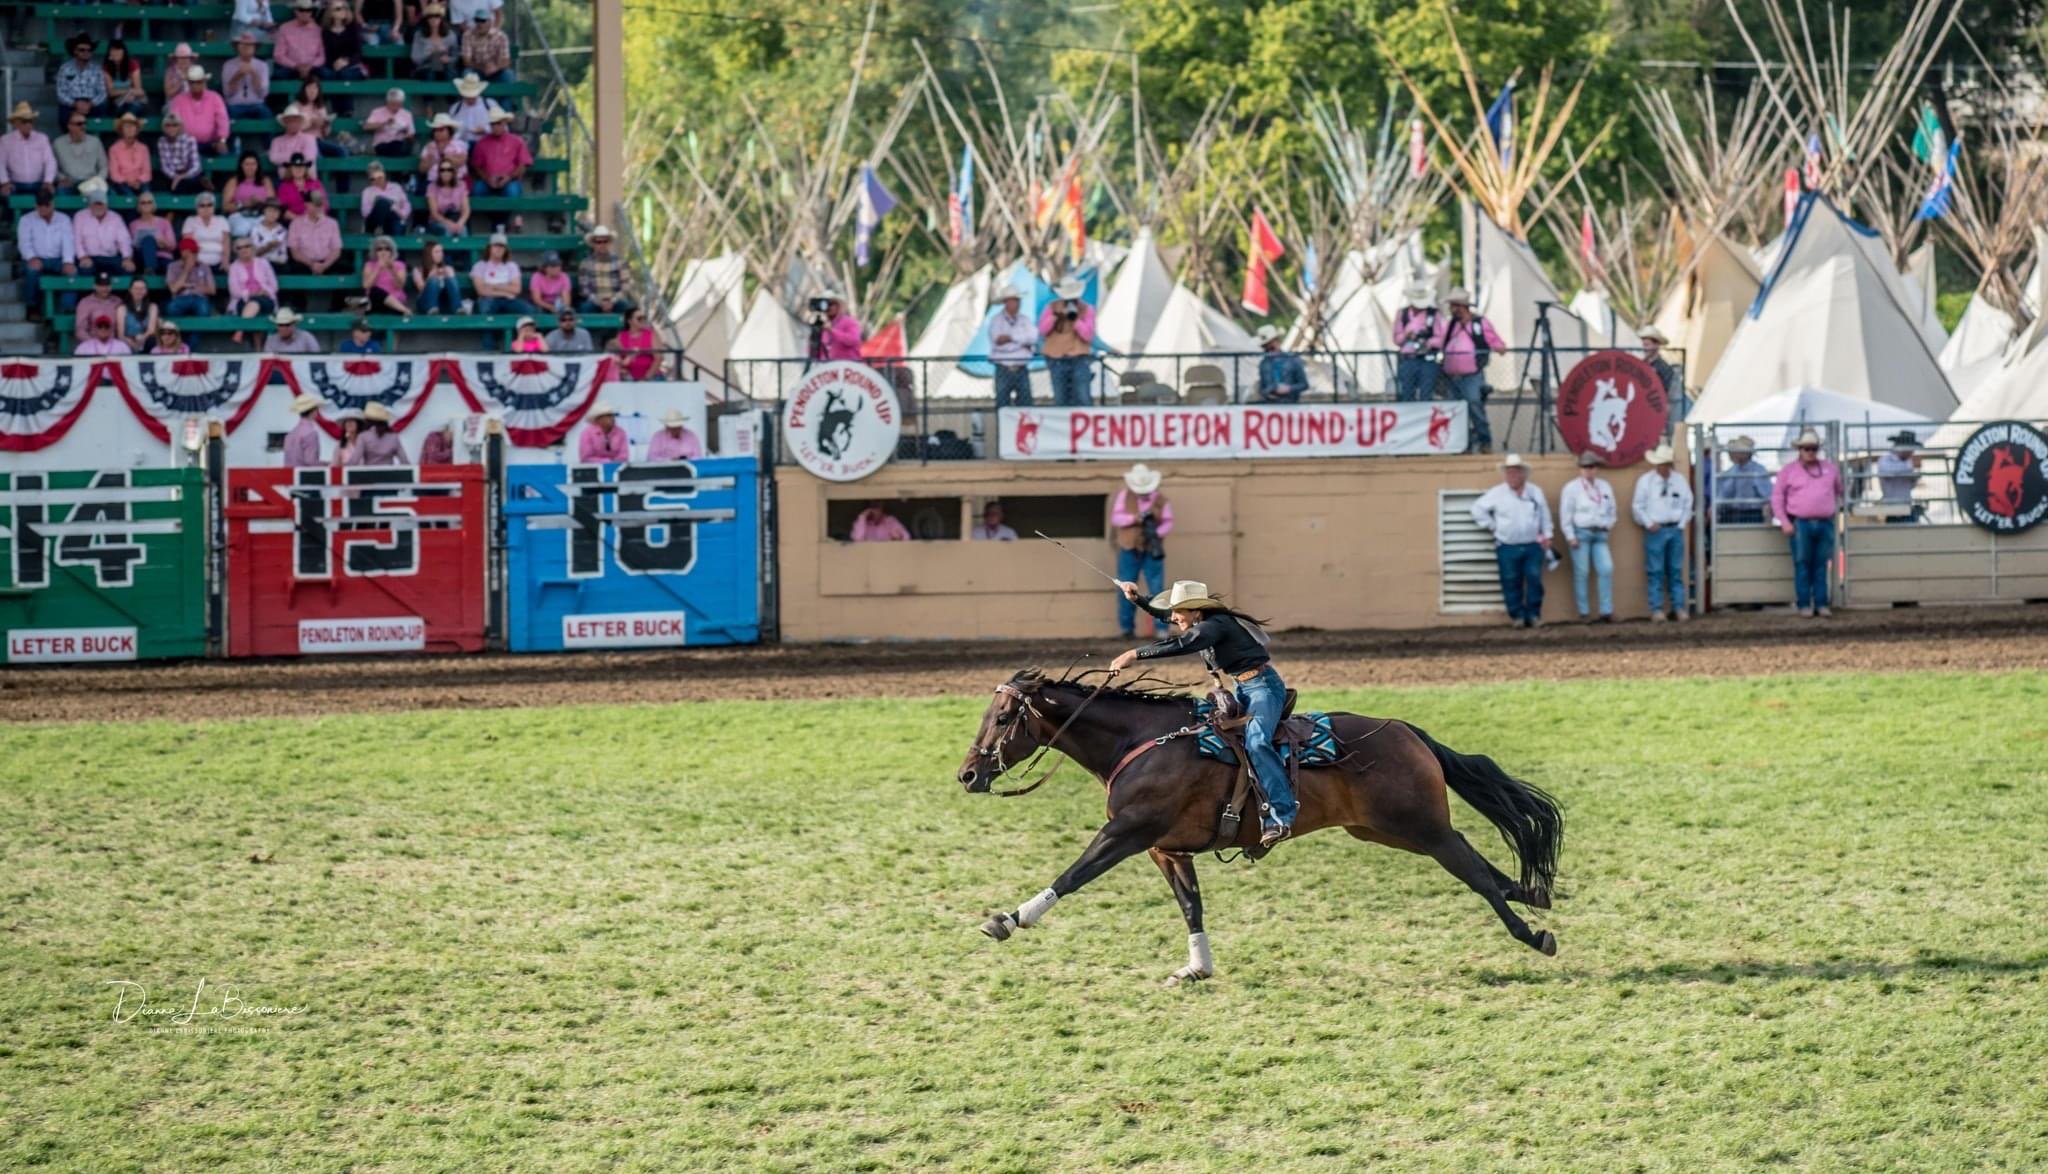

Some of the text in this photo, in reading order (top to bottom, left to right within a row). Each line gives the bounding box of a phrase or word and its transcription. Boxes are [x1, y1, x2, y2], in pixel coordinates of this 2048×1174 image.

[789, 367, 892, 428] PENDLETON ROUND UP
[1069, 411, 1231, 453] PENDLETON
[1956, 424, 2009, 485] PENDLETON
[2010, 423, 2048, 460] ROUND
[10, 470, 147, 588] 14
[293, 466, 420, 578] 15
[567, 461, 699, 579] 16
[12, 635, 134, 655] LET'ER BUCK
[301, 624, 422, 643] PENDLETON ROUND-UP
[567, 619, 682, 639] LET'ER BUCK
